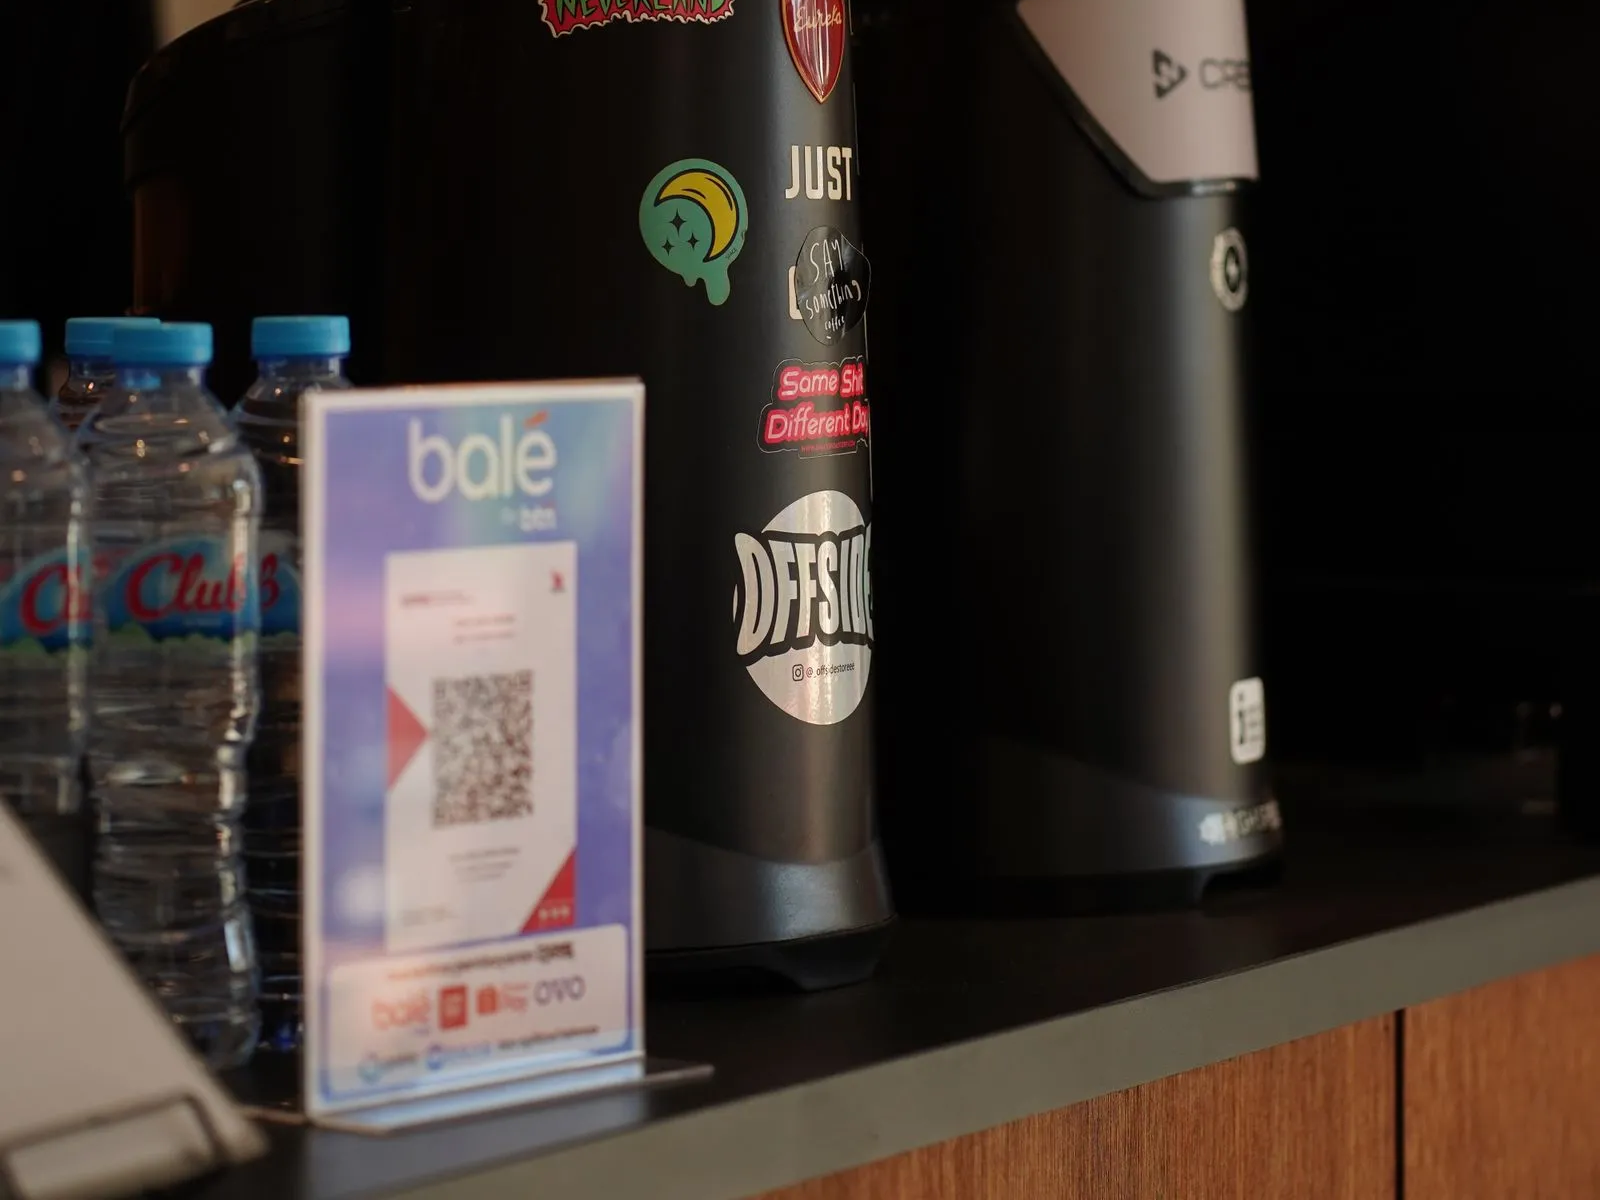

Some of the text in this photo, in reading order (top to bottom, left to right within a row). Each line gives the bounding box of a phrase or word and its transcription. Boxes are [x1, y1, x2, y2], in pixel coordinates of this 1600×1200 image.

[785, 144, 853, 201] JUST
[810, 239, 843, 284] SAY
[781, 370, 839, 397] Same
[767, 406, 850, 440] Different
